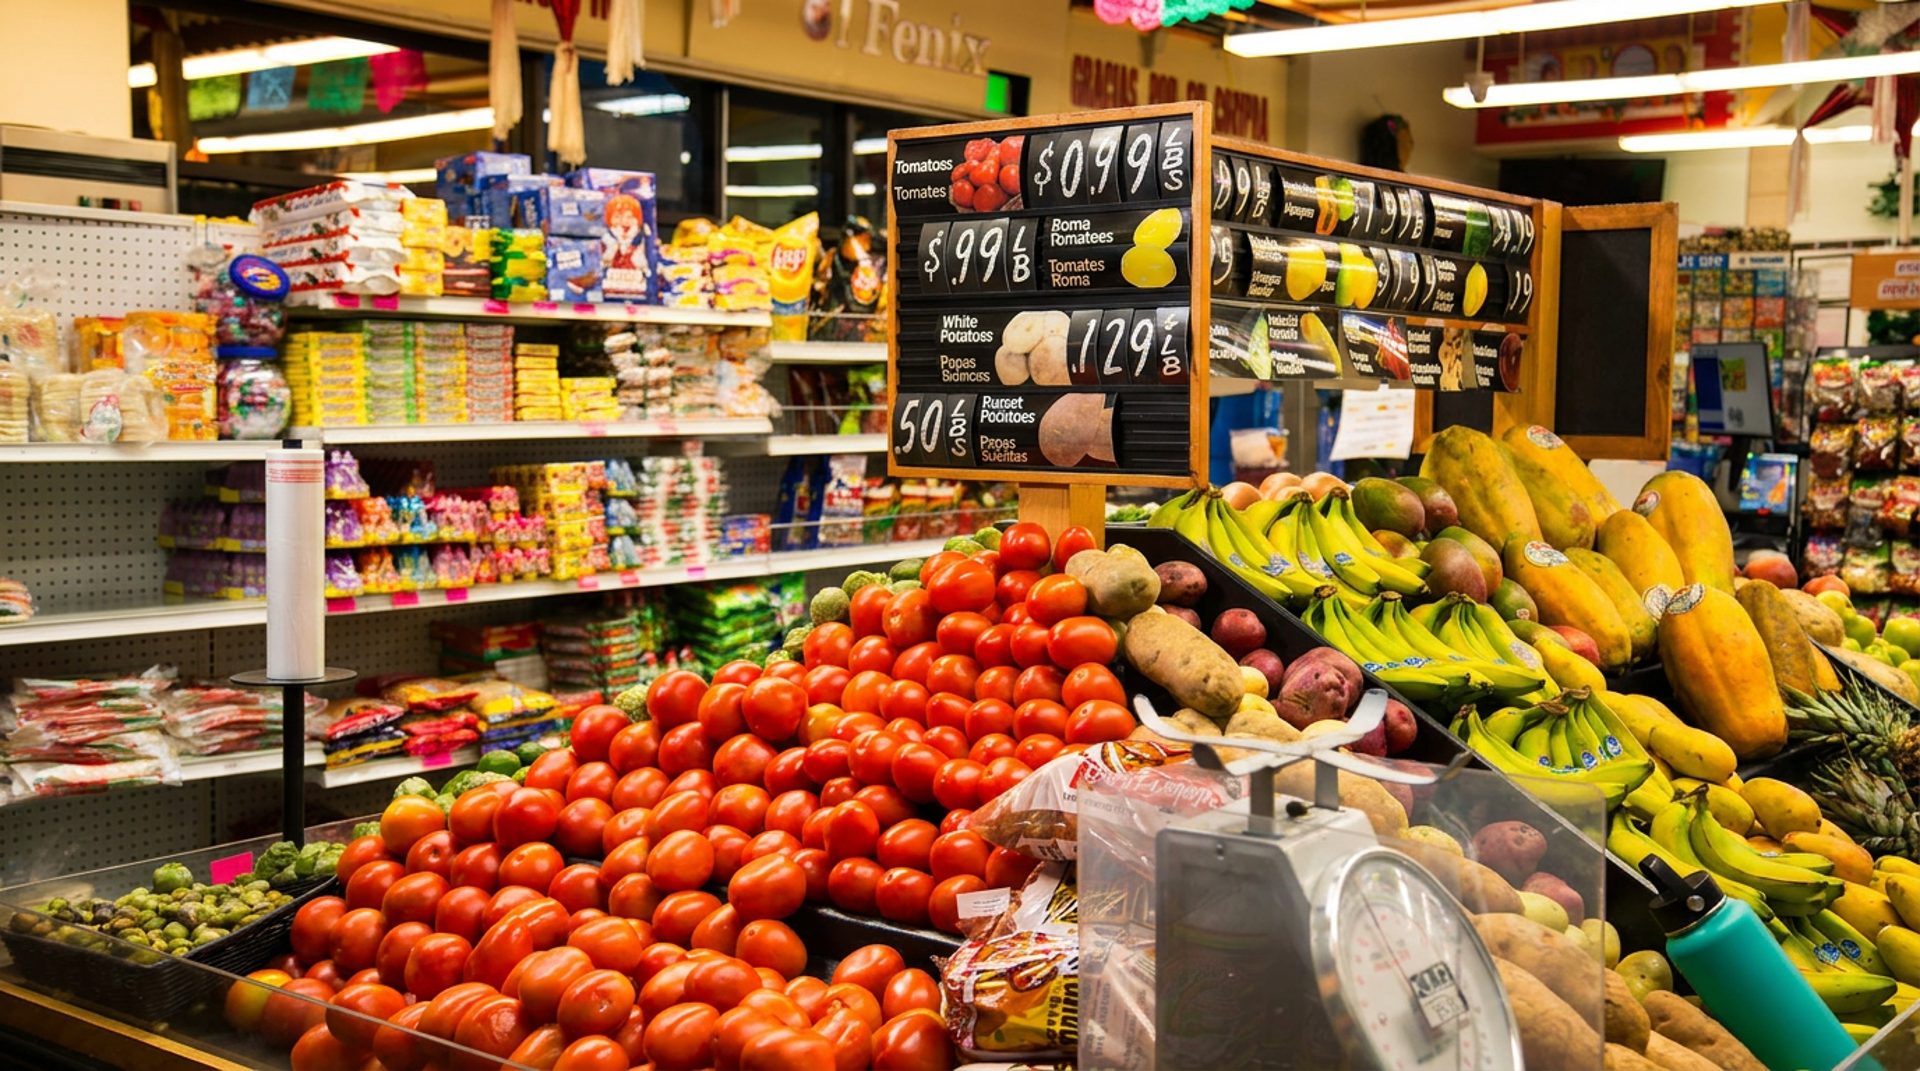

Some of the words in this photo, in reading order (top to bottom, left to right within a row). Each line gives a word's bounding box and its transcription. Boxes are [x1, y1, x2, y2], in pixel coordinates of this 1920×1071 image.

[1033, 132, 1152, 198] $0.99
[894, 185, 947, 200] Tomates
[924, 226, 1003, 286] $.99
[1012, 225, 1031, 284] LB
[1048, 258, 1105, 273] Tomates
[1051, 273, 1091, 287] Roma
[942, 314, 979, 329] White
